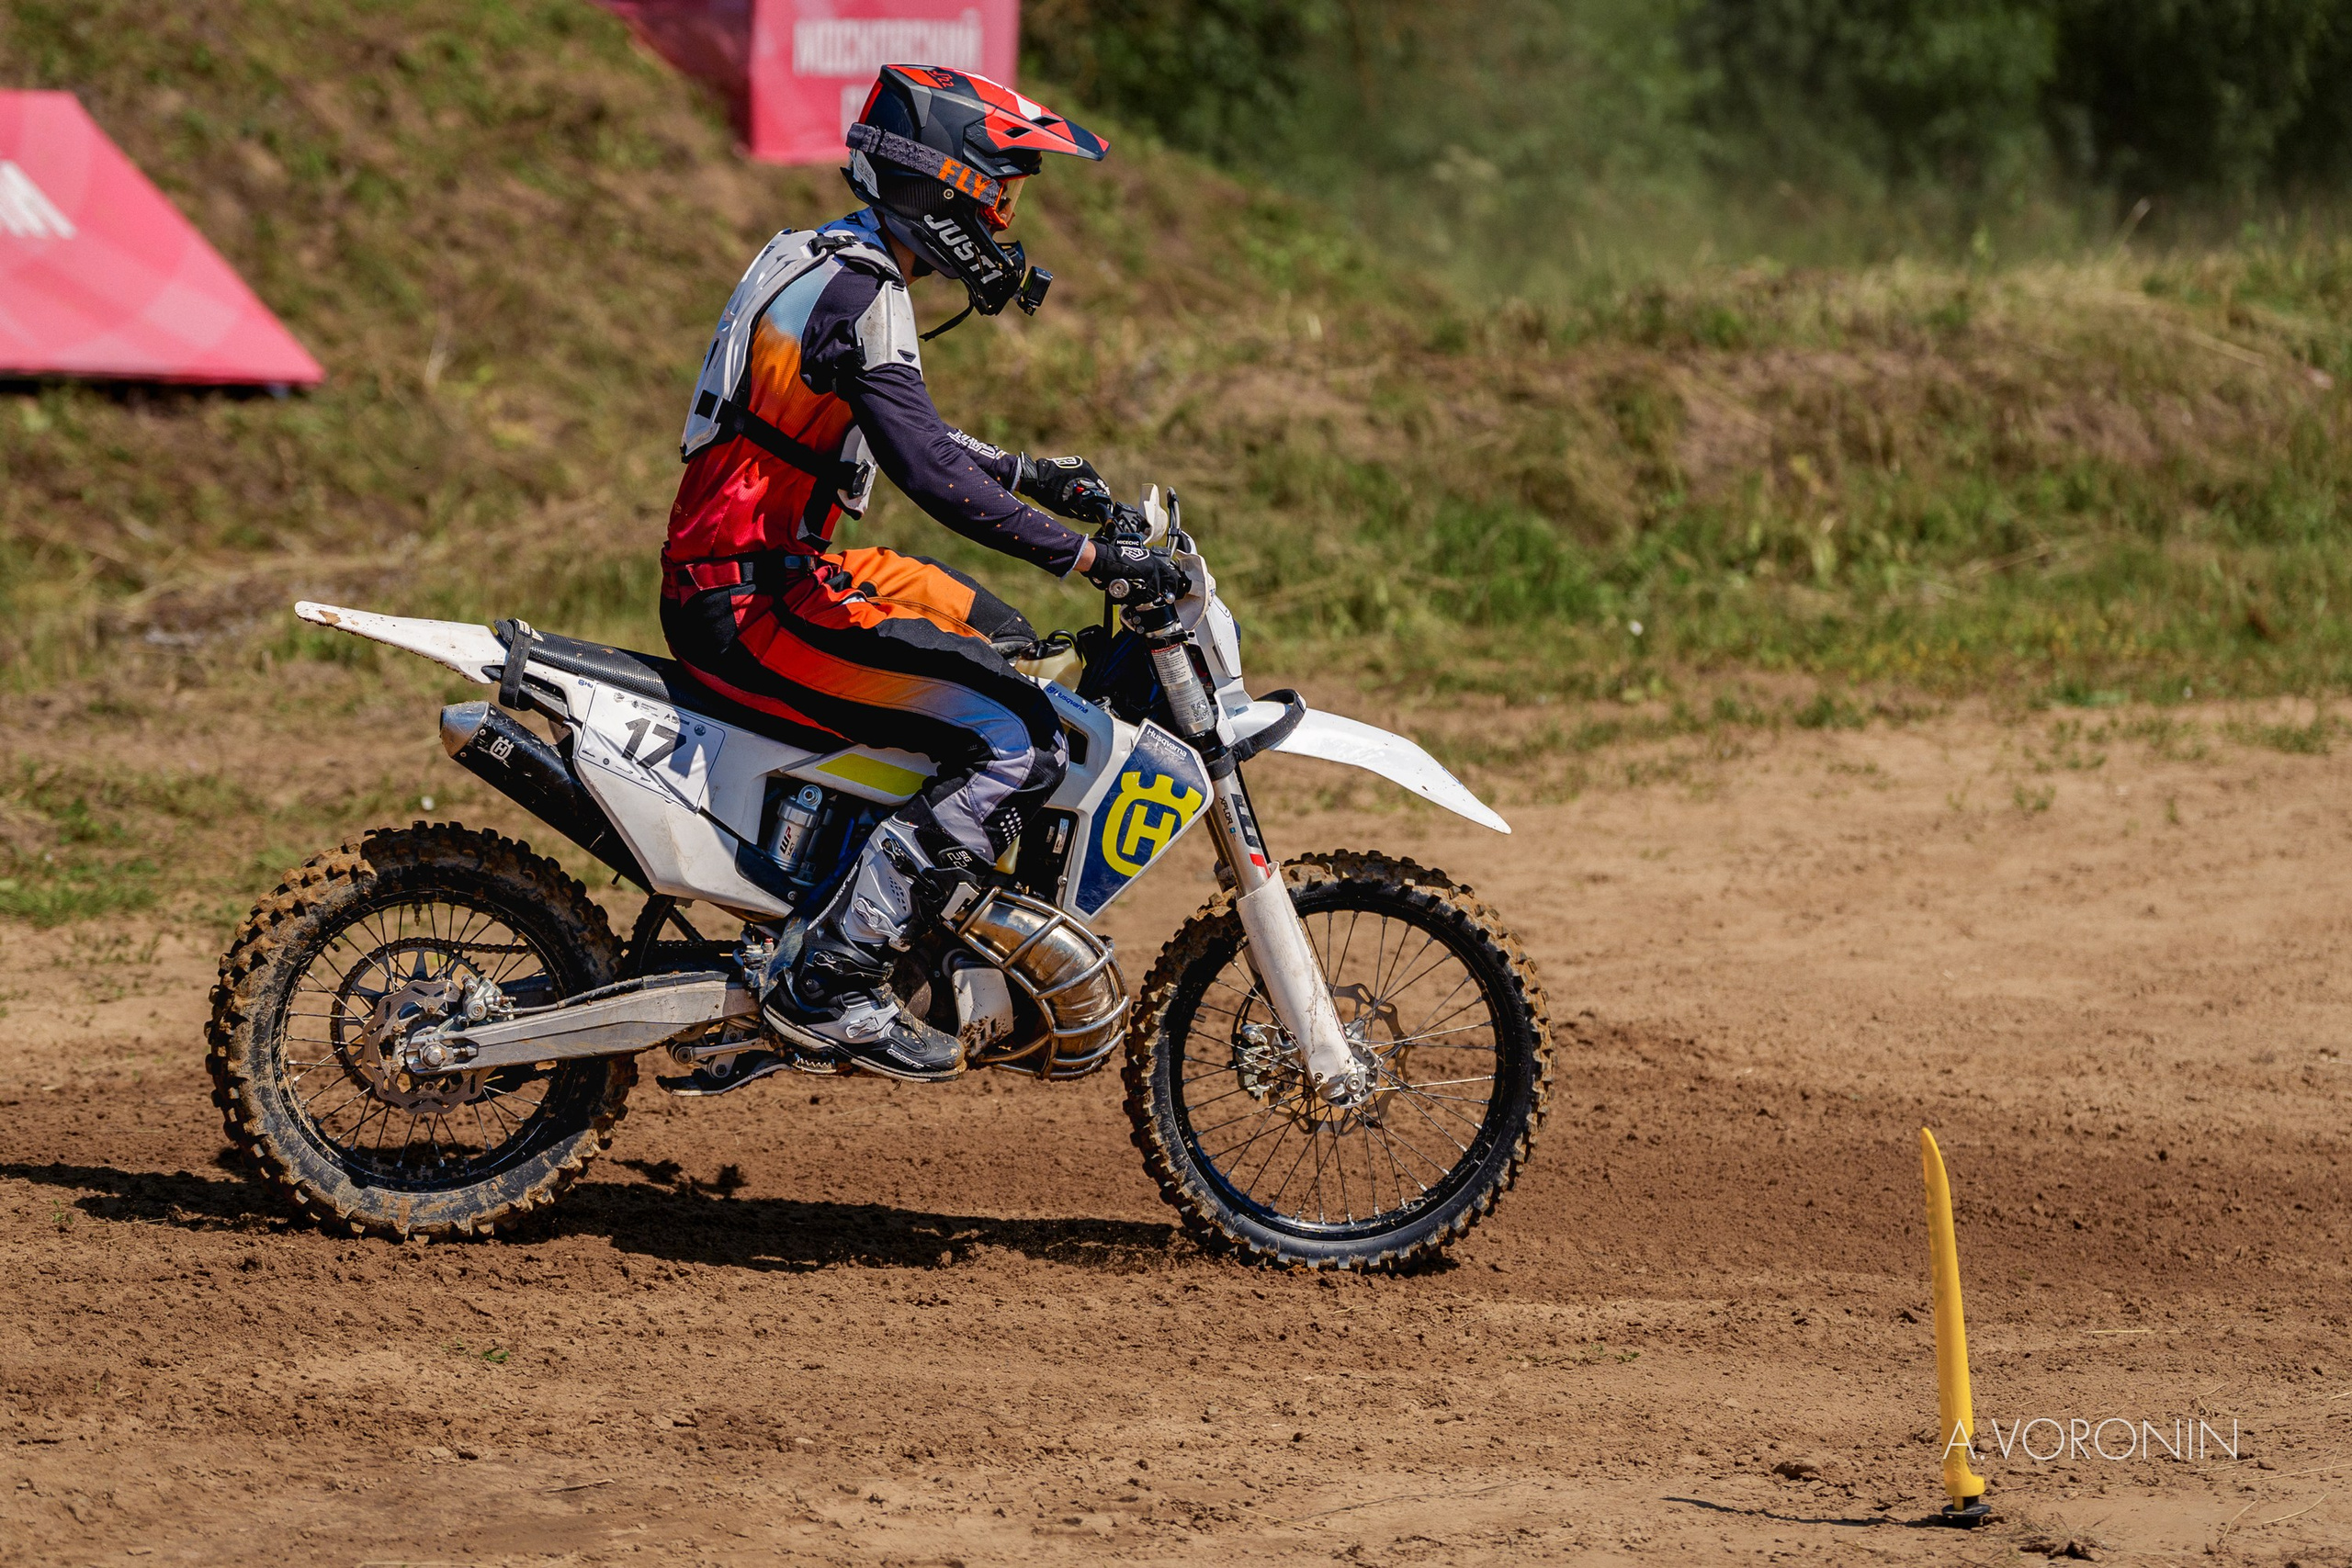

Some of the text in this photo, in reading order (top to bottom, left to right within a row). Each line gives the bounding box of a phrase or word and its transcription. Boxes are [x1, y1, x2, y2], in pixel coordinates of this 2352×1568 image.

[937, 157, 991, 198] FLY
[1053, 690, 1089, 714] Husqvarna
[621, 717, 687, 770] 17
[1146, 728, 1188, 758] Husqvarna
[1219, 795, 1233, 825] XPLOR
[780, 826, 791, 854] WP
[947, 852, 967, 868] 22
[958, 851, 972, 863] SG
